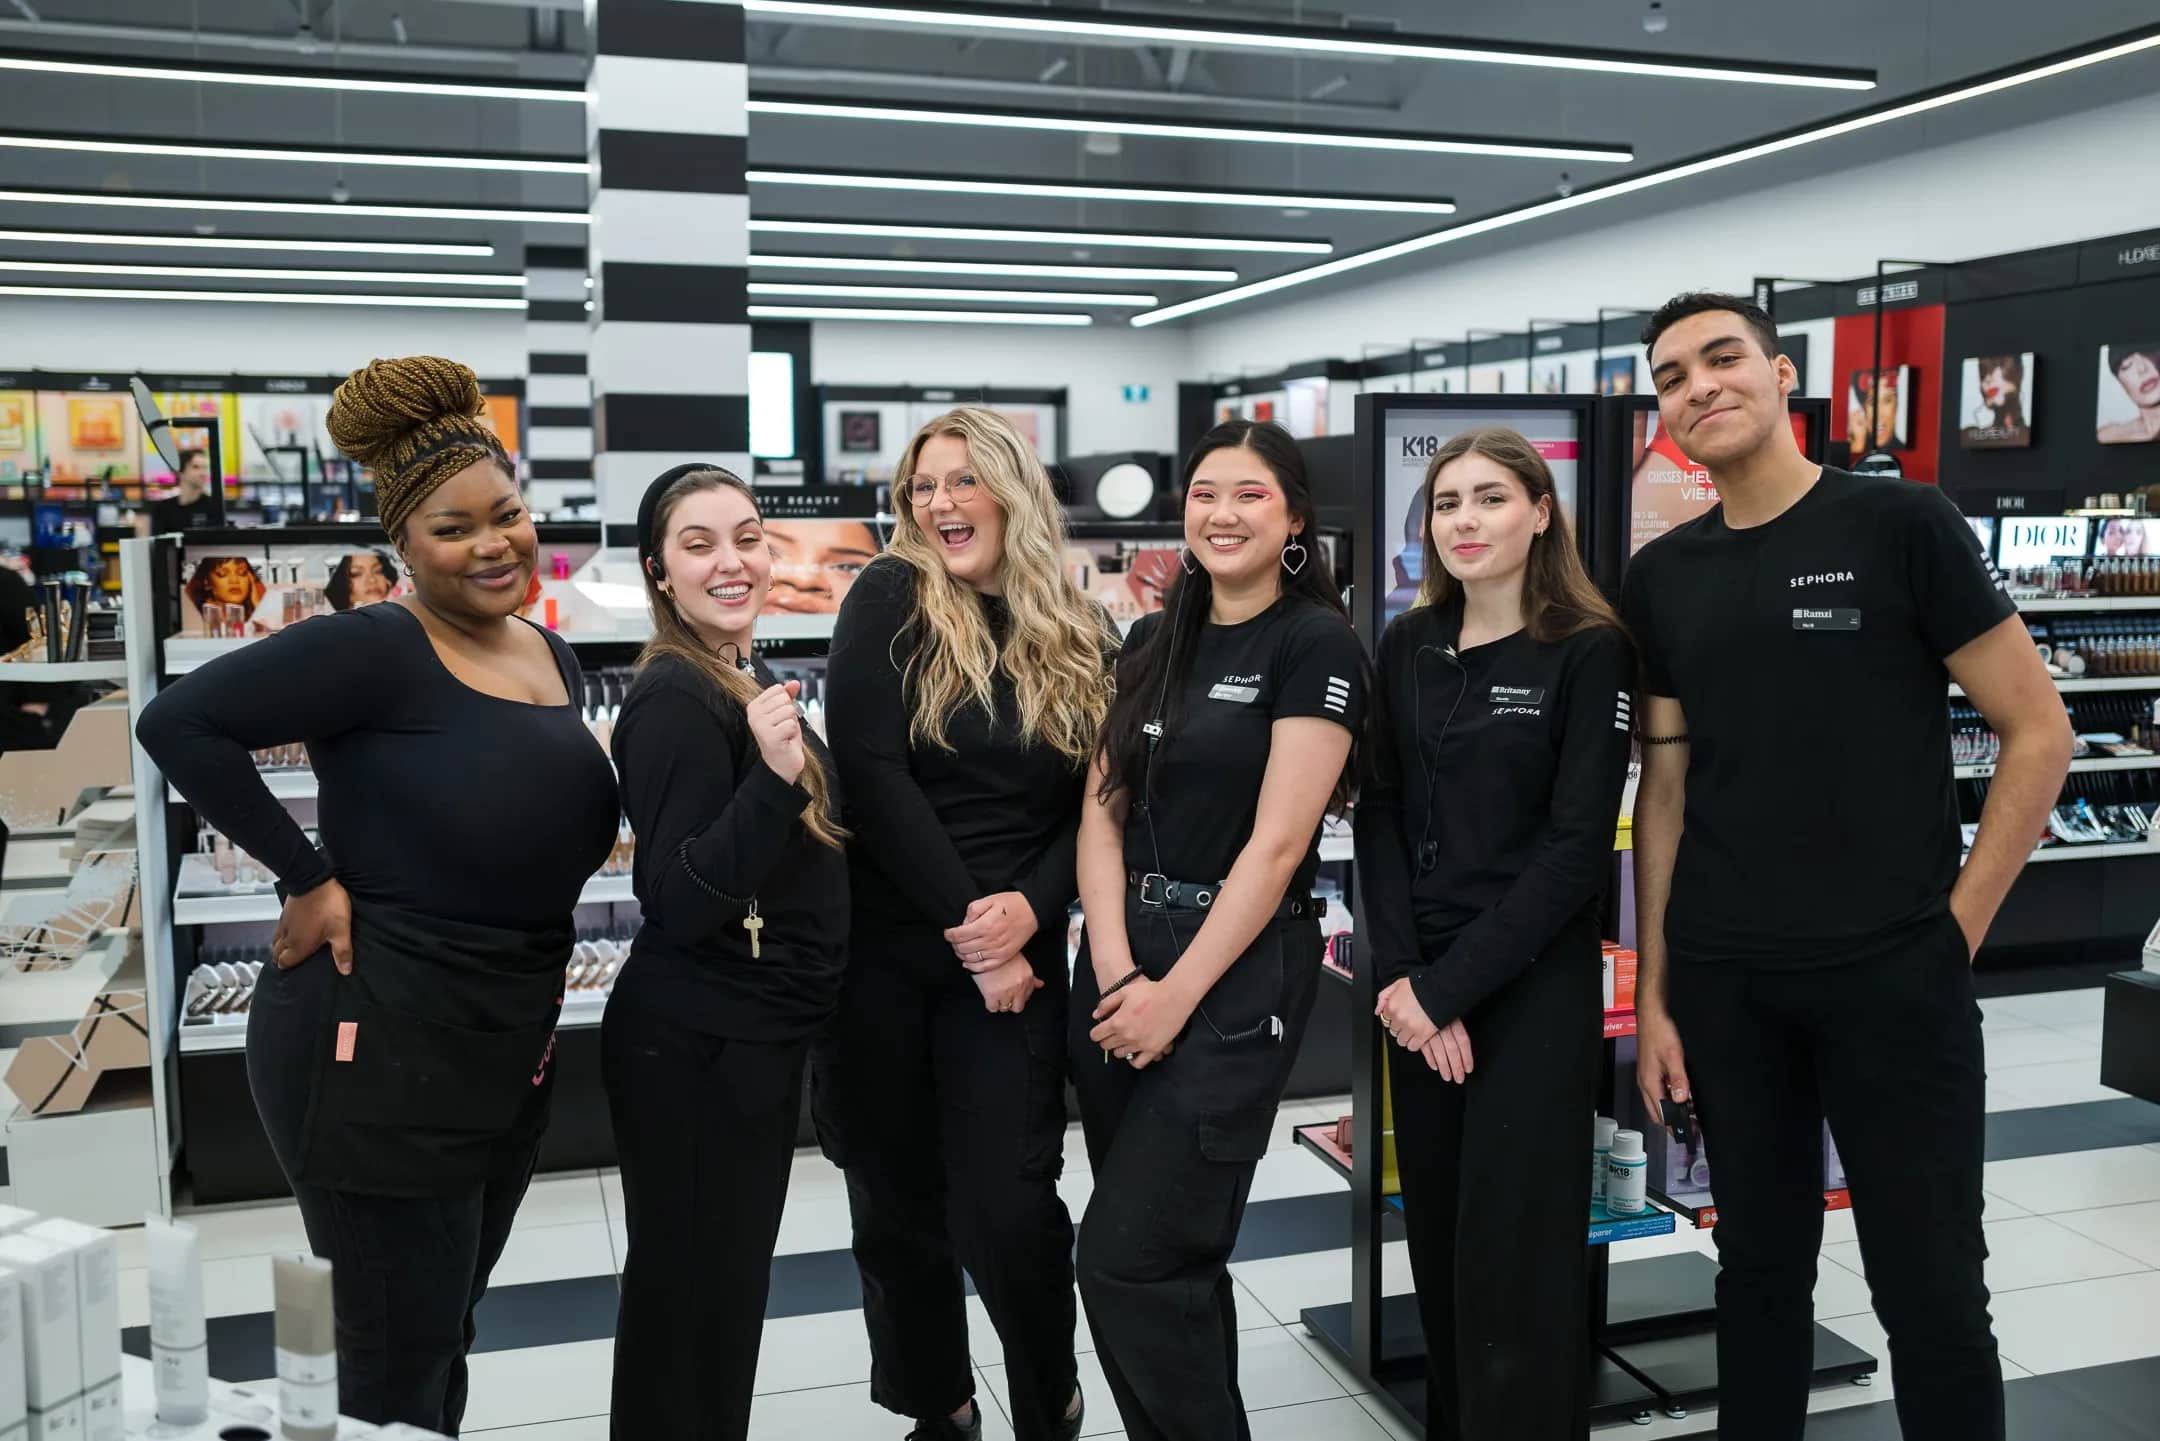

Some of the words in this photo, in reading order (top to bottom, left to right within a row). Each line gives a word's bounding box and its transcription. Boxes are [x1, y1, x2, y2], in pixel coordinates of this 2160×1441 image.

[1402, 435, 1439, 457] K18
[787, 496, 841, 505] BEAUTY
[1680, 487, 1706, 501] VIE
[1997, 496, 2025, 509] DIOR
[2013, 524, 2078, 547] DIOR
[1789, 571, 1855, 588] SEPHORA
[752, 640, 785, 648] AUTY
[1222, 673, 1263, 685] SEPHOR
[1614, 1167, 1630, 1178] K18
